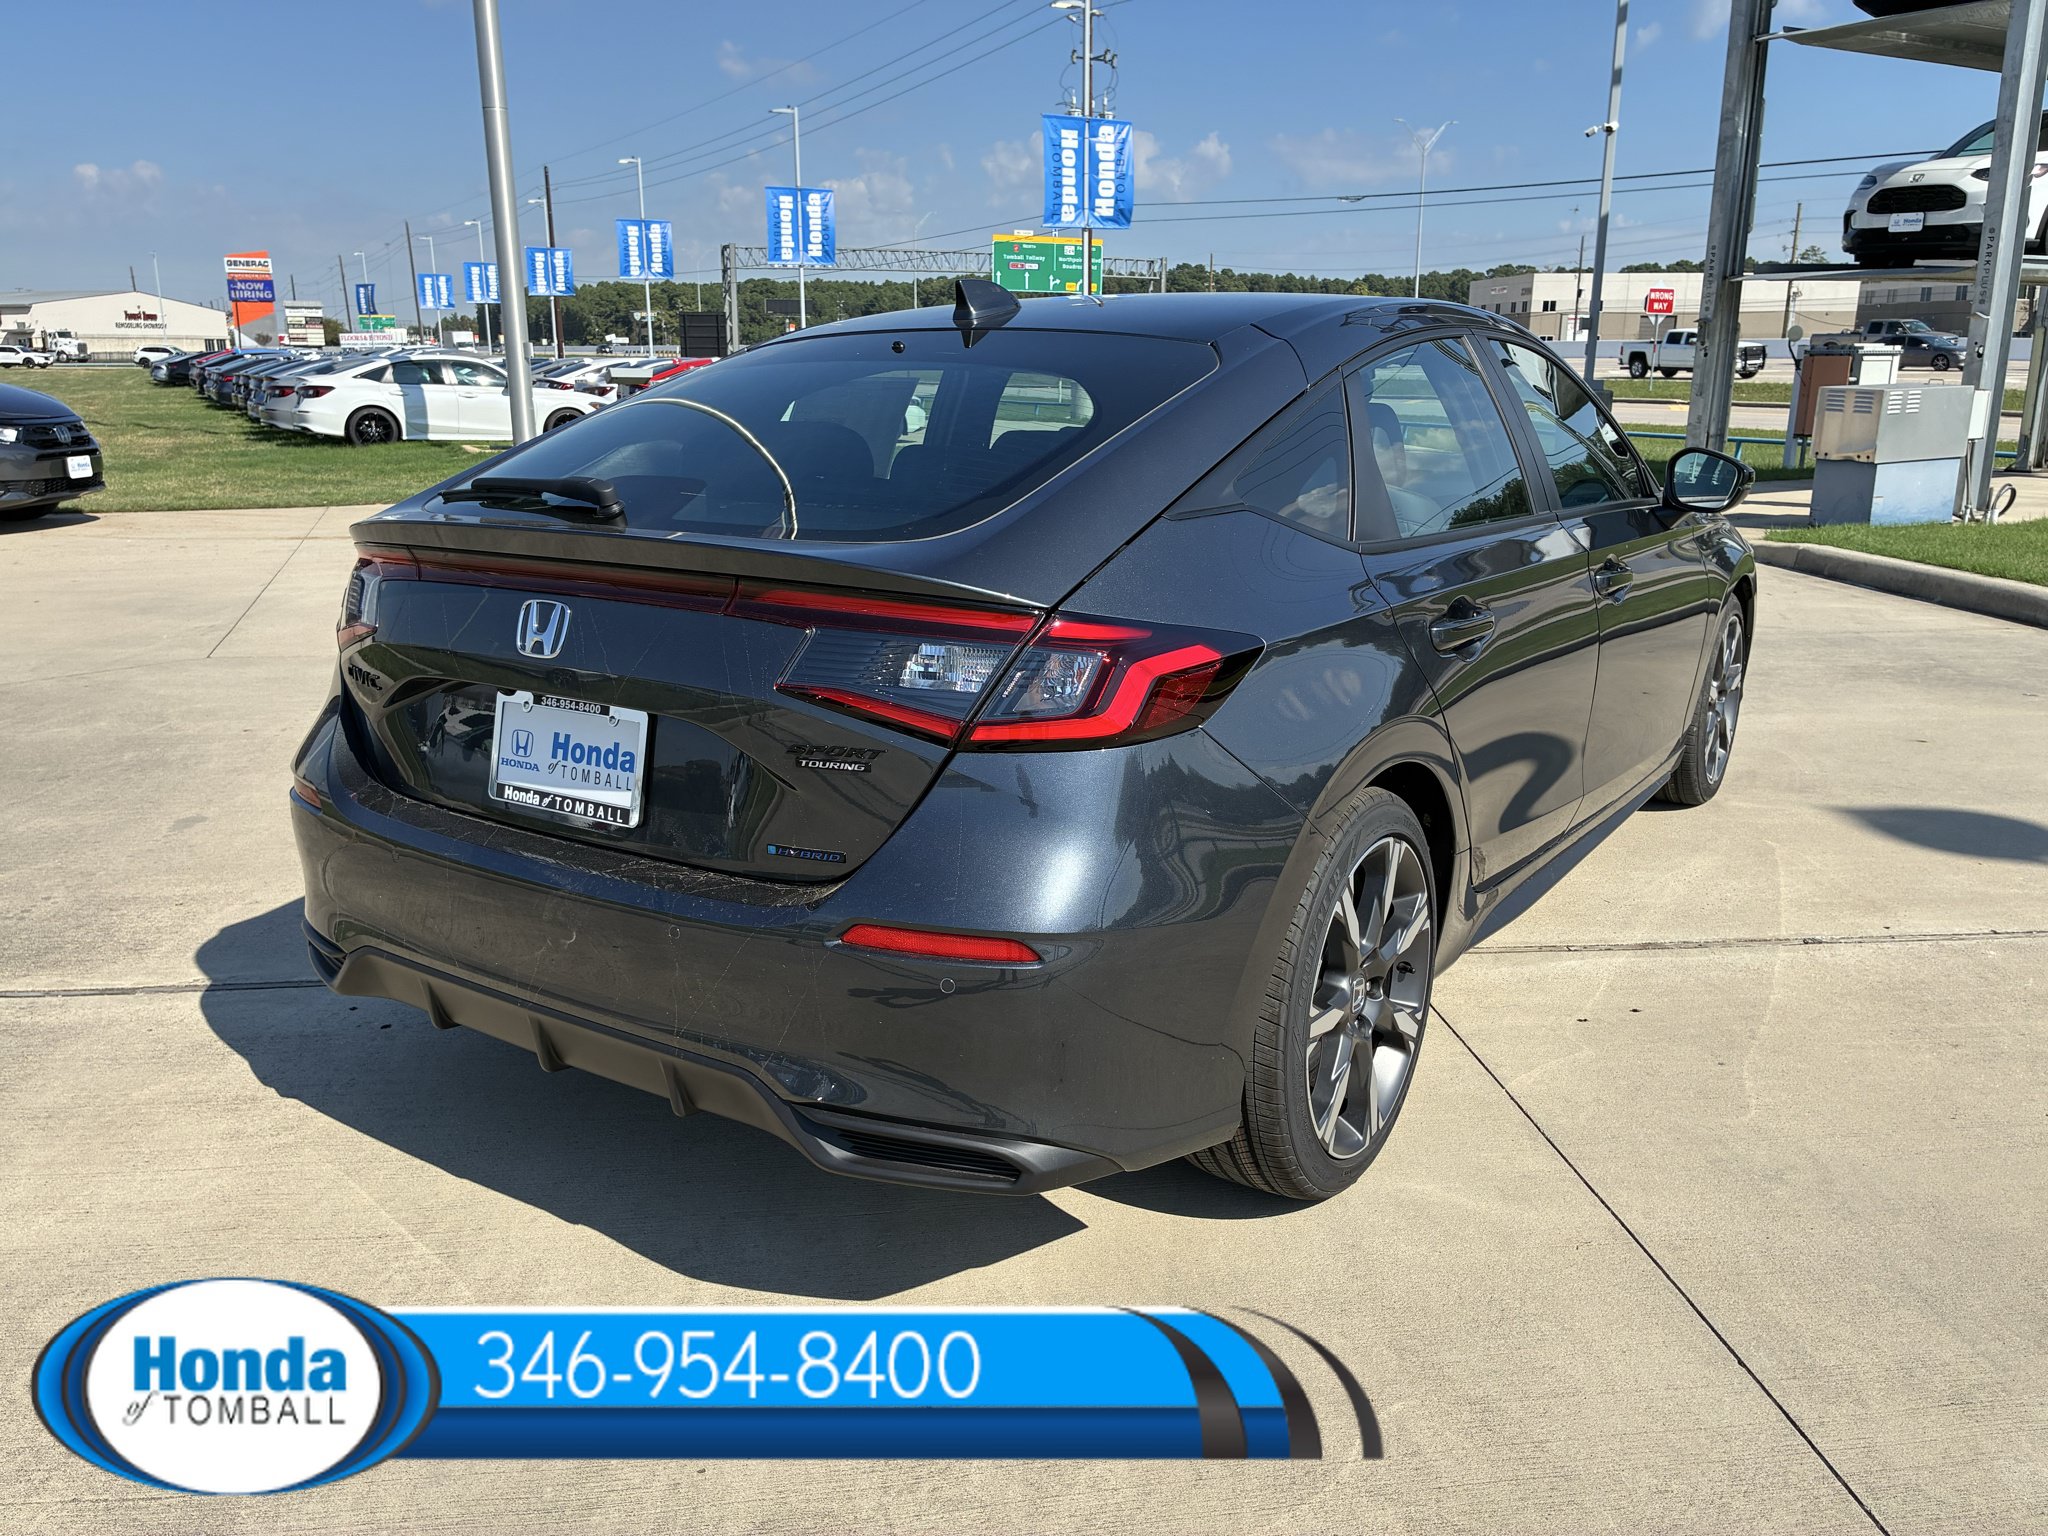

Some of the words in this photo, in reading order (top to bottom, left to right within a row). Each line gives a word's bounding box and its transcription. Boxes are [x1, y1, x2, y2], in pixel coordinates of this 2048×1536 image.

[1051, 143, 1061, 220] TOMBALL
[1061, 129, 1078, 222] Honda
[1095, 125, 1116, 217] Honda
[779, 195, 795, 261] Honda
[806, 193, 822, 257] Honda
[226, 259, 270, 268] GENERAC
[627, 225, 641, 276] Honda
[649, 224, 663, 273] Honda
[470, 266, 482, 301] Honda
[486, 264, 499, 300] Honda
[535, 252, 547, 293] Honda
[554, 250, 566, 291] Honda
[1980, 236, 1995, 297] PARKPLUS
[231, 290, 273, 299] HIRING
[236, 281, 264, 290] NOW
[424, 277, 434, 308] Honda
[437, 275, 449, 306] Honda
[1650, 291, 1674, 301] WRONG
[1653, 301, 1669, 310] WAY
[541, 697, 602, 714] 346-954-8400
[500, 757, 541, 772] HONDA
[551, 731, 636, 774] Honda
[786, 743, 889, 760] SPORT
[800, 759, 866, 772] TOURING
[547, 760, 561, 775] of
[562, 765, 633, 791] TOMBALL
[504, 785, 540, 806] Honda
[541, 795, 554, 808] of
[554, 796, 624, 823] TOMBALL
[778, 847, 842, 863] HYBRID
